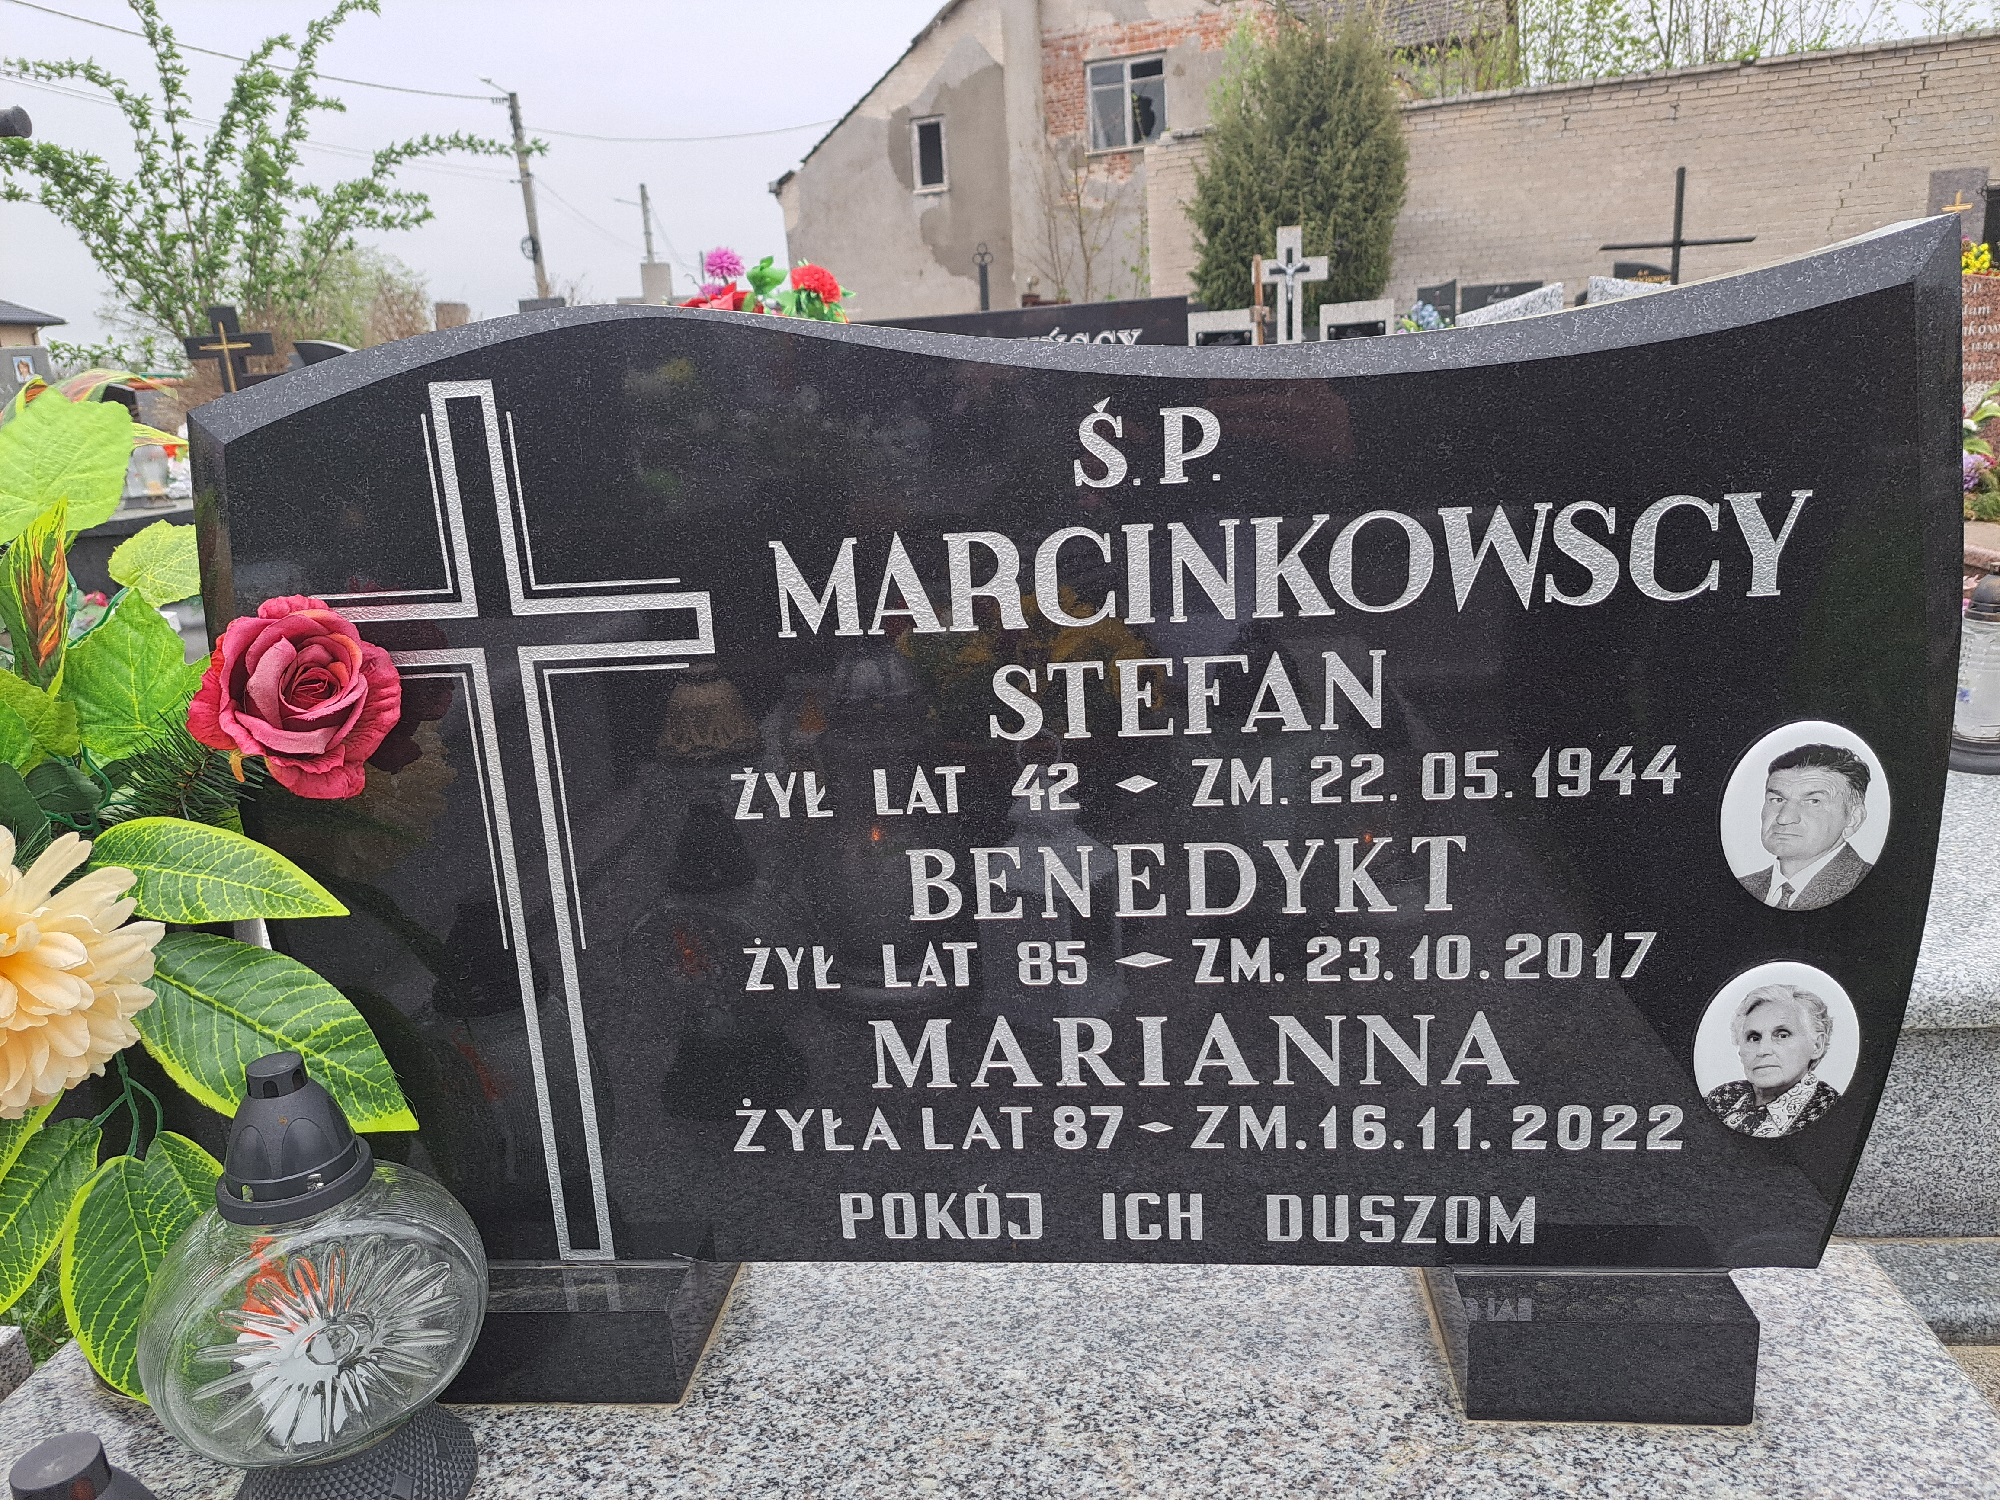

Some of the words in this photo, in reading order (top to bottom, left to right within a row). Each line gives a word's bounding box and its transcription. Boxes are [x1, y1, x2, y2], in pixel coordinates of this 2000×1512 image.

[767, 489, 1815, 640] MARCINKOWSCY
[988, 649, 1388, 743] STEFAN
[729, 765, 834, 821] ŻYŁ
[872, 765, 966, 817] LAT
[1010, 762, 1081, 812] 42
[1191, 756, 1289, 808] ZM.
[1530, 744, 1682, 799] 1944
[903, 835, 1468, 923] BENEDYKT
[742, 936, 842, 992] ŻYŁ
[880, 941, 978, 990] LAT
[1016, 940, 1089, 987] 85
[1190, 936, 1285, 985] ZM.
[866, 1010, 1521, 1090] MARIANNA
[732, 1097, 902, 1153] ŻYŁA
[921, 1105, 1034, 1152] LAT
[1052, 1104, 1124, 1151] 87
[838, 1182, 1044, 1241] POKÓJ
[1101, 1191, 1204, 1242] ICH
[1265, 1193, 1537, 1246] DUSZOM
